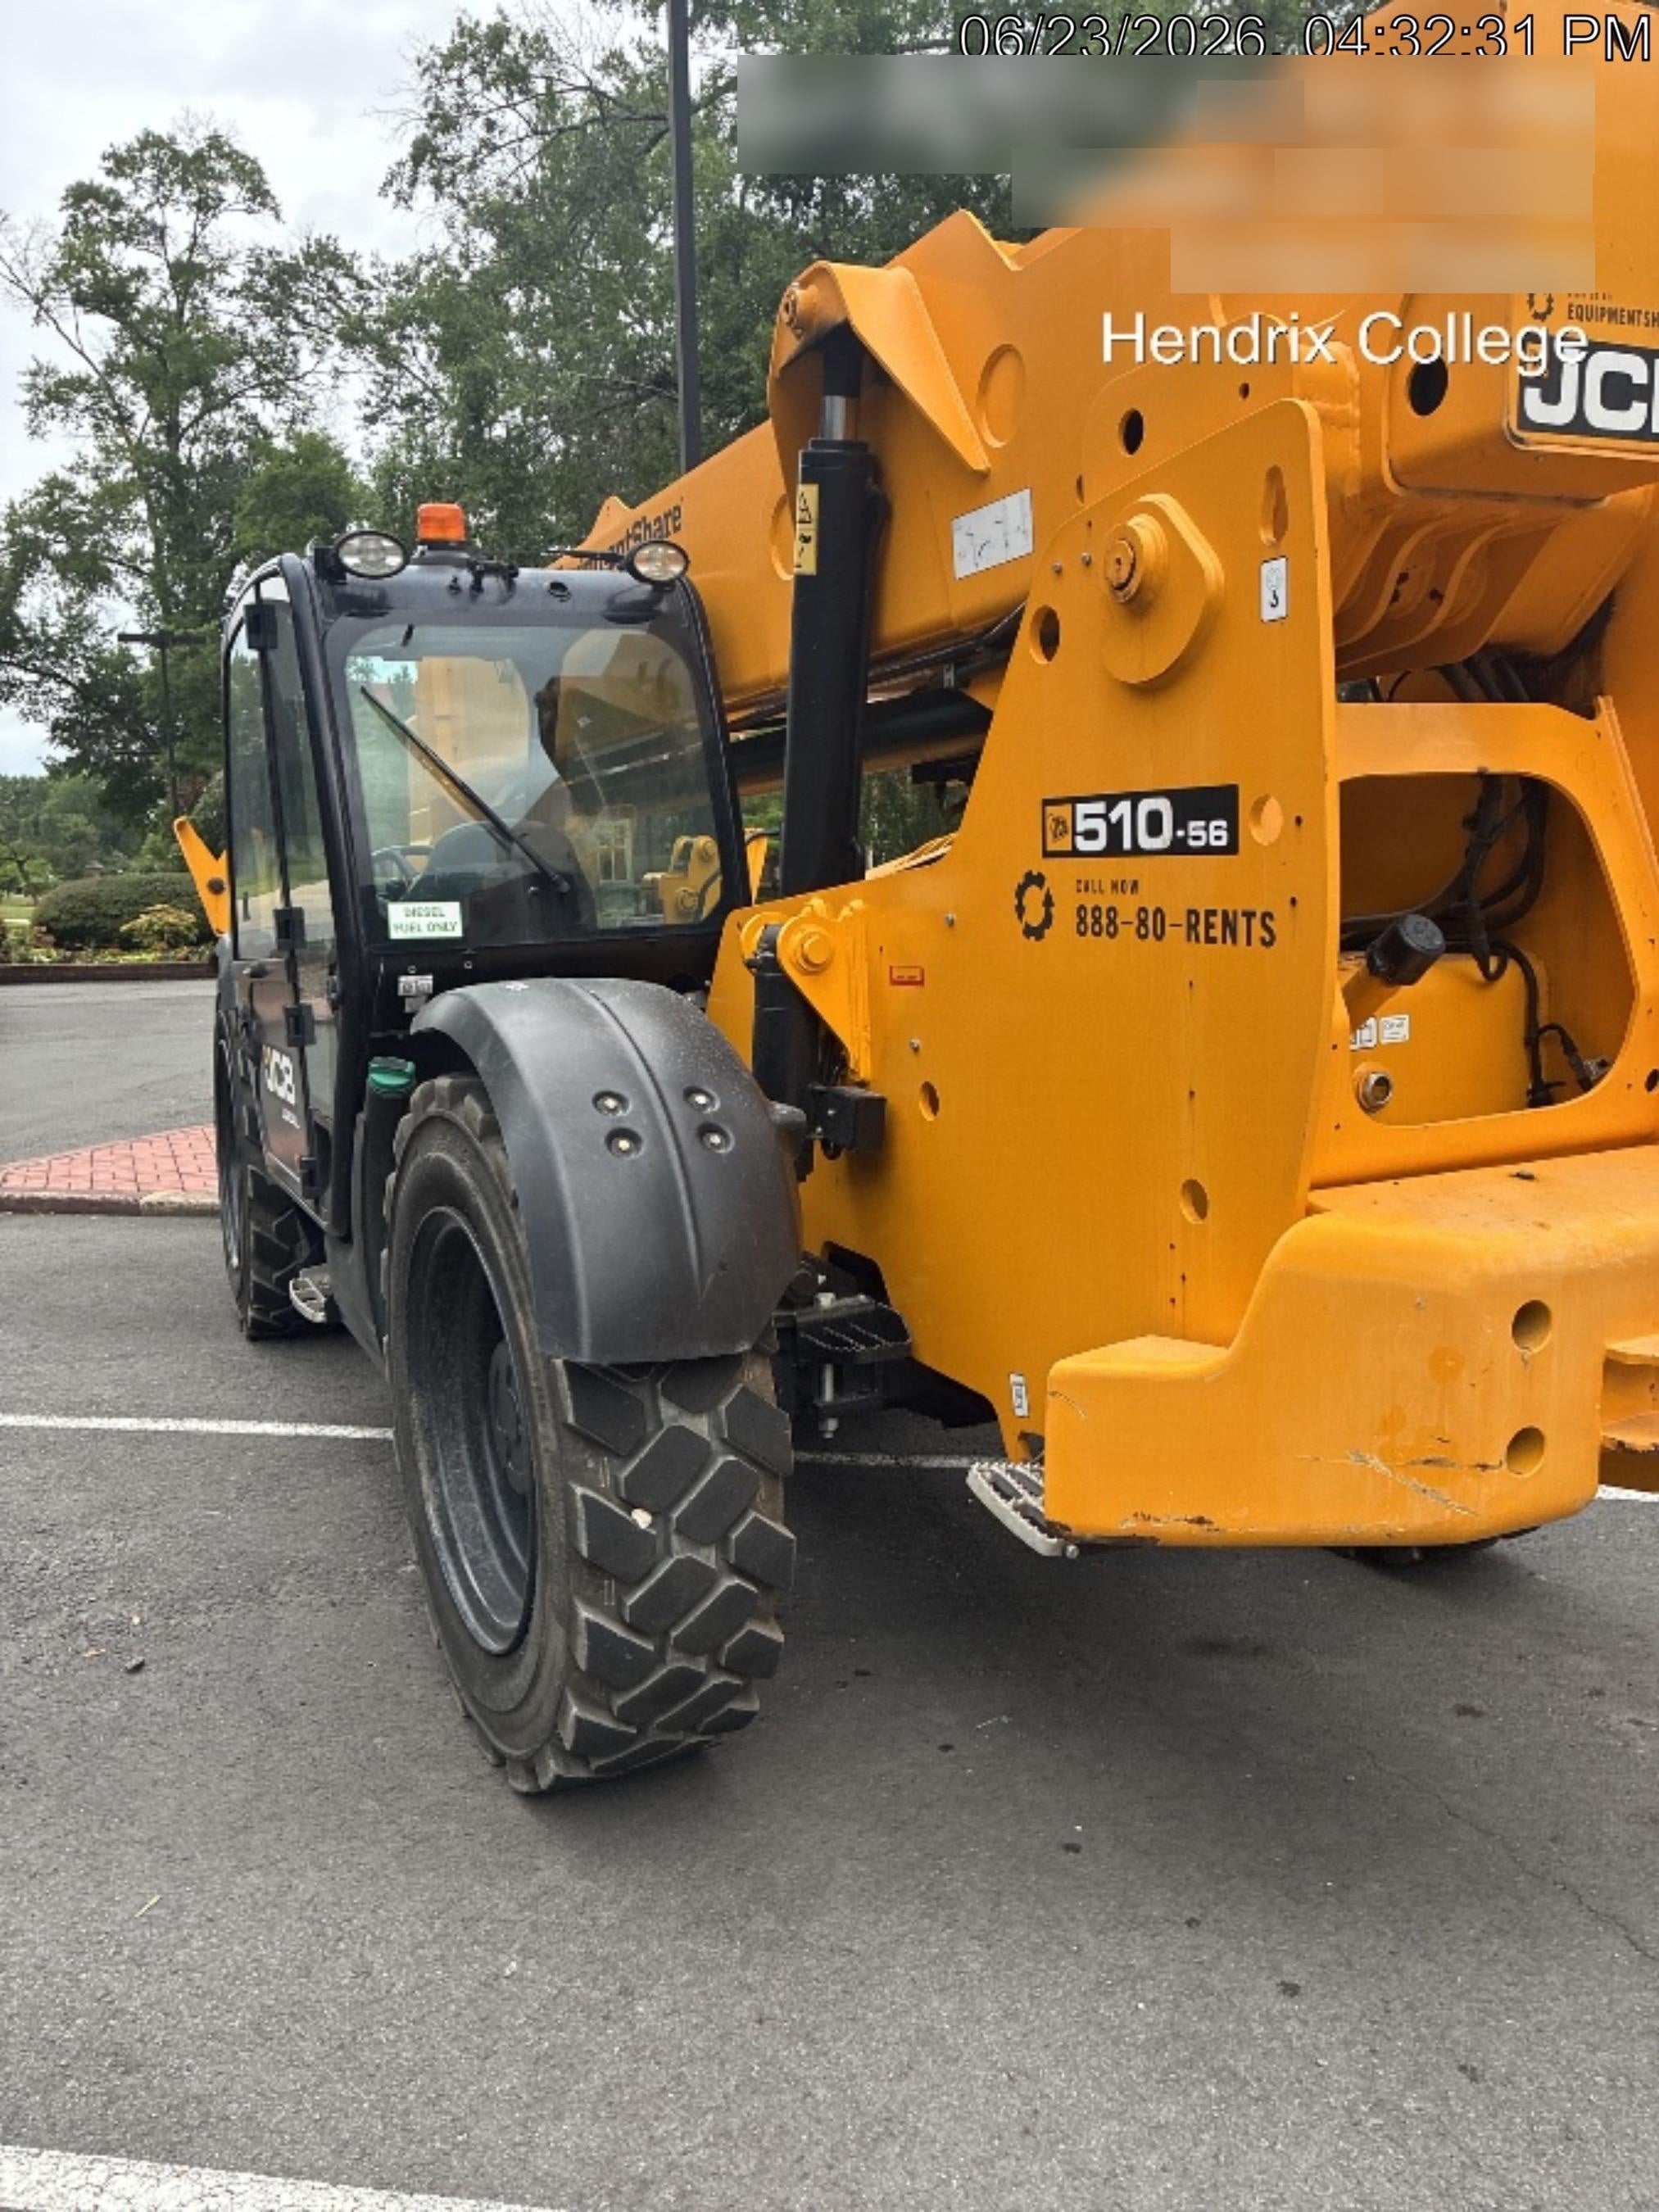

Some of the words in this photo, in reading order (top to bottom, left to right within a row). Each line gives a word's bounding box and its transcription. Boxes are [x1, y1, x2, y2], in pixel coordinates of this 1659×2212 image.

[1524, 347, 1659, 433] JC
[1076, 879, 1104, 894] CALL
[1111, 879, 1140, 895] NOW
[405, 906, 445, 918] DIESEL
[392, 921, 422, 933] FUEL
[426, 921, 458, 932] ONLY
[1076, 904, 1276, 948] 888-80-RENTS
